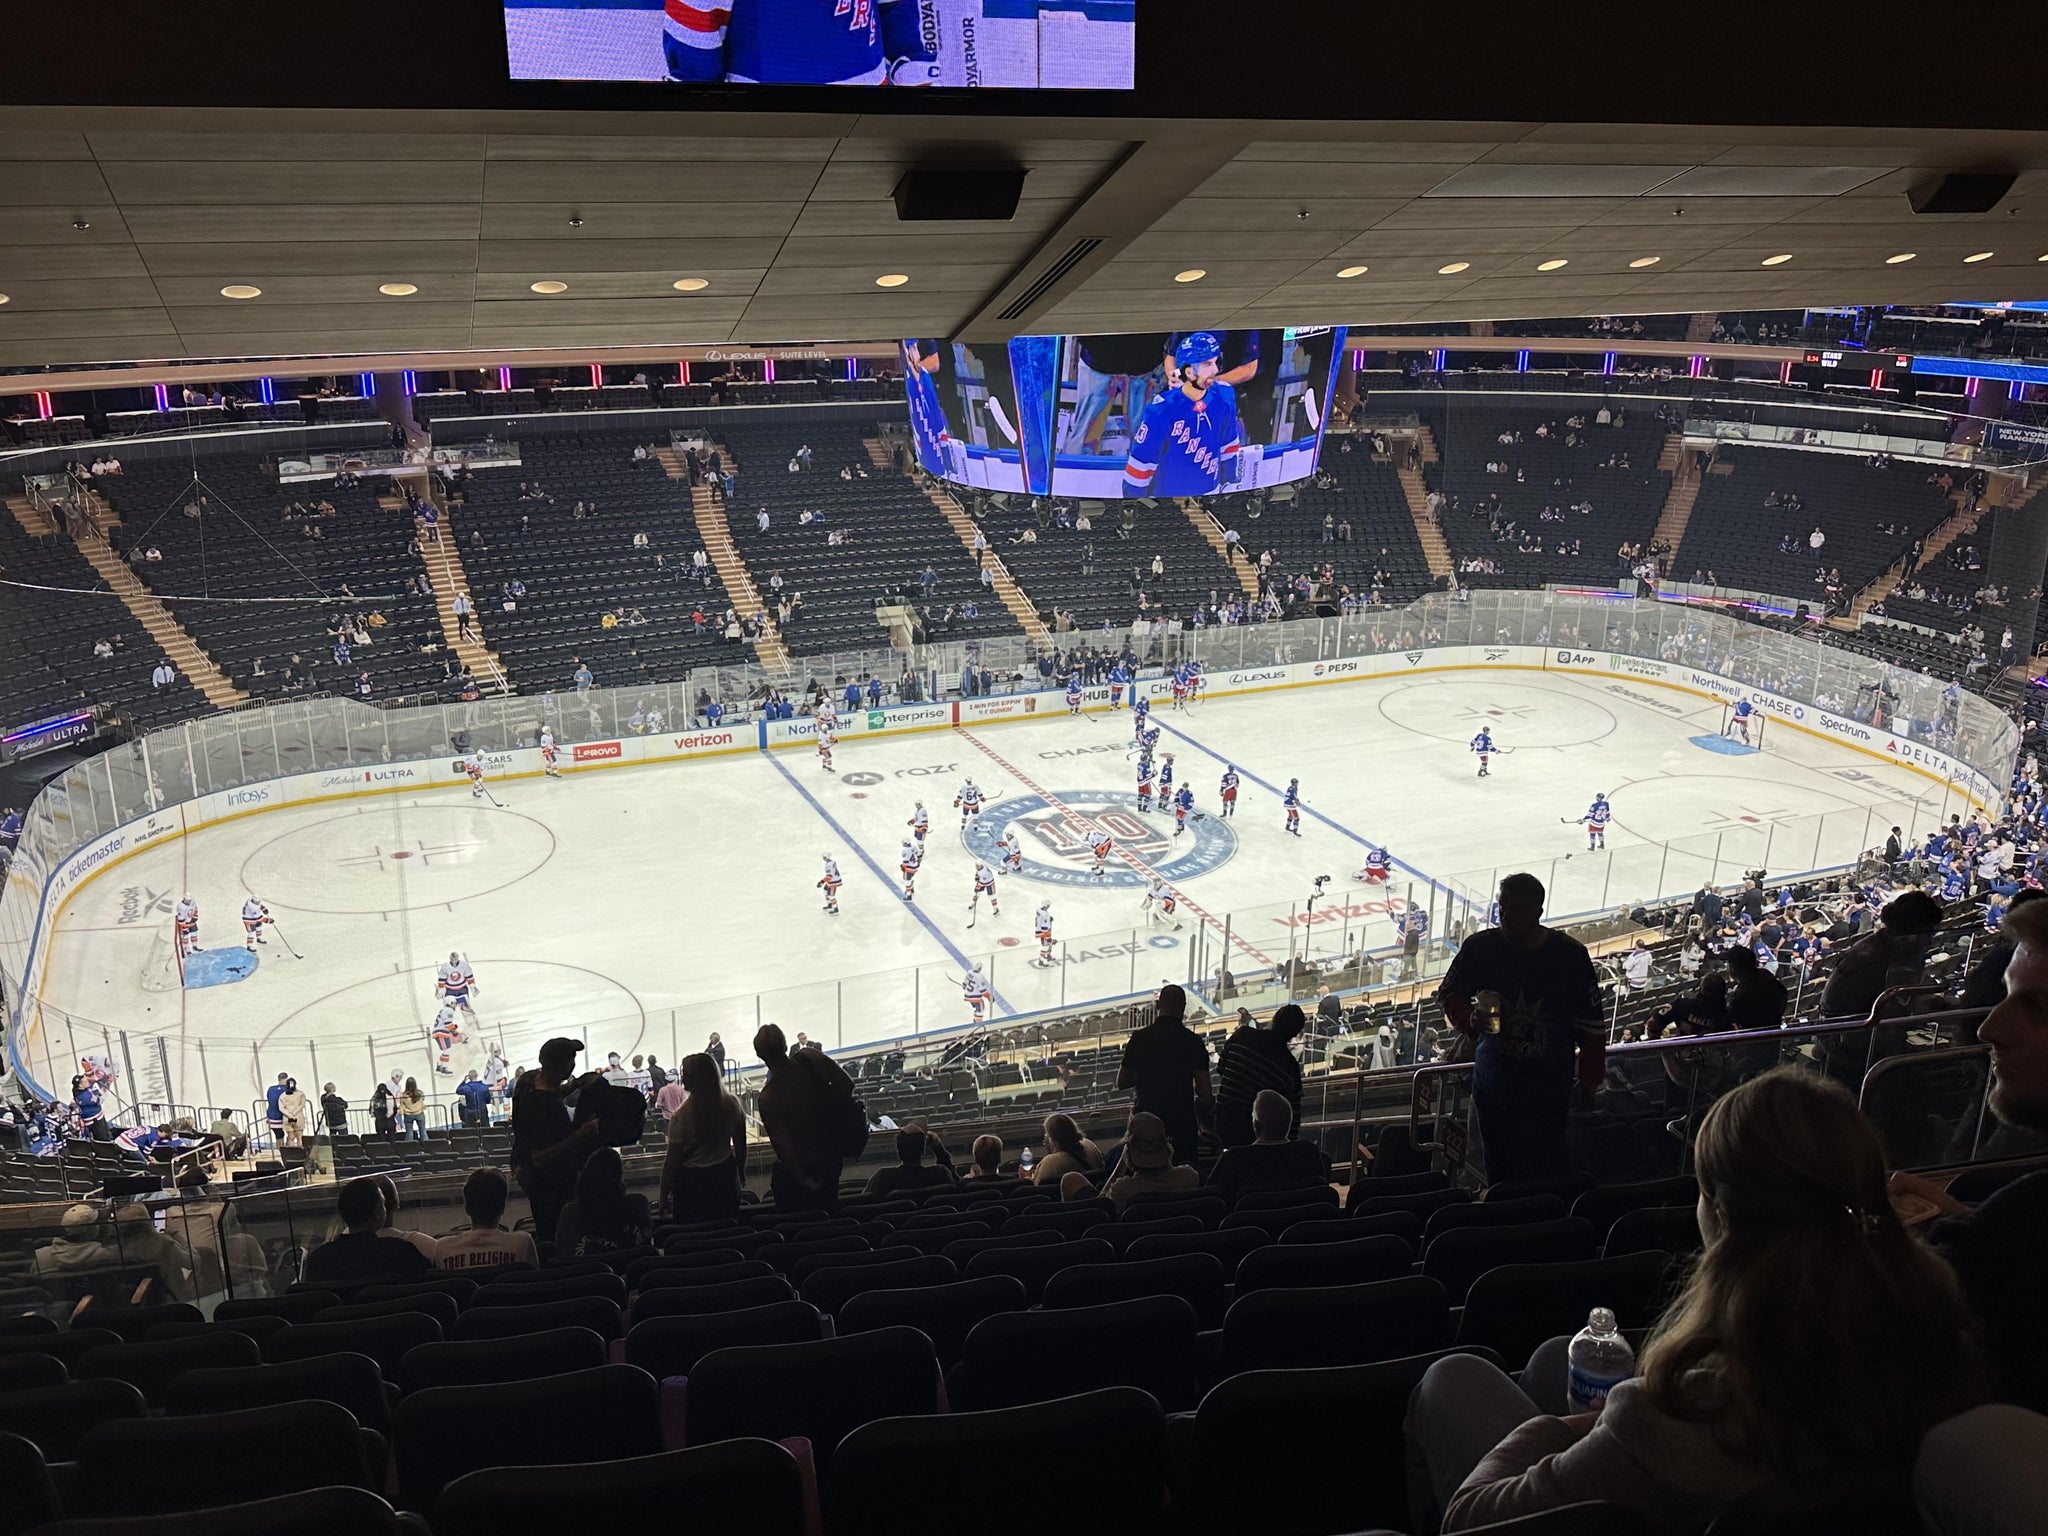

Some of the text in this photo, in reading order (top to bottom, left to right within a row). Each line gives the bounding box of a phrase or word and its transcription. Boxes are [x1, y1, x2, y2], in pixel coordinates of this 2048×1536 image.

[723, 352, 766, 360] LEXUS
[804, 351, 828, 359] LEVEL
[1822, 352, 1842, 360] STARS
[1328, 662, 1357, 673] PEPSI
[1244, 671, 1286, 682] LEXUS
[1691, 673, 1742, 697] Northwell
[1751, 693, 1793, 716] CHASE
[53, 723, 88, 741] ULTRA
[1819, 714, 1869, 740] Spectrum
[674, 732, 732, 749] verizon
[577, 746, 618, 758] Lenovo
[1038, 742, 1123, 760] CHASE
[1902, 744, 1948, 773] DELTA
[374, 769, 414, 780] ULTRA
[894, 762, 959, 778] razr
[227, 788, 269, 807] Infosys
[965, 791, 978, 801] 64
[68, 835, 125, 882] ticketmaster
[1271, 896, 1408, 928] verizon
[444, 1251, 516, 1269] TRUE RELIGION
